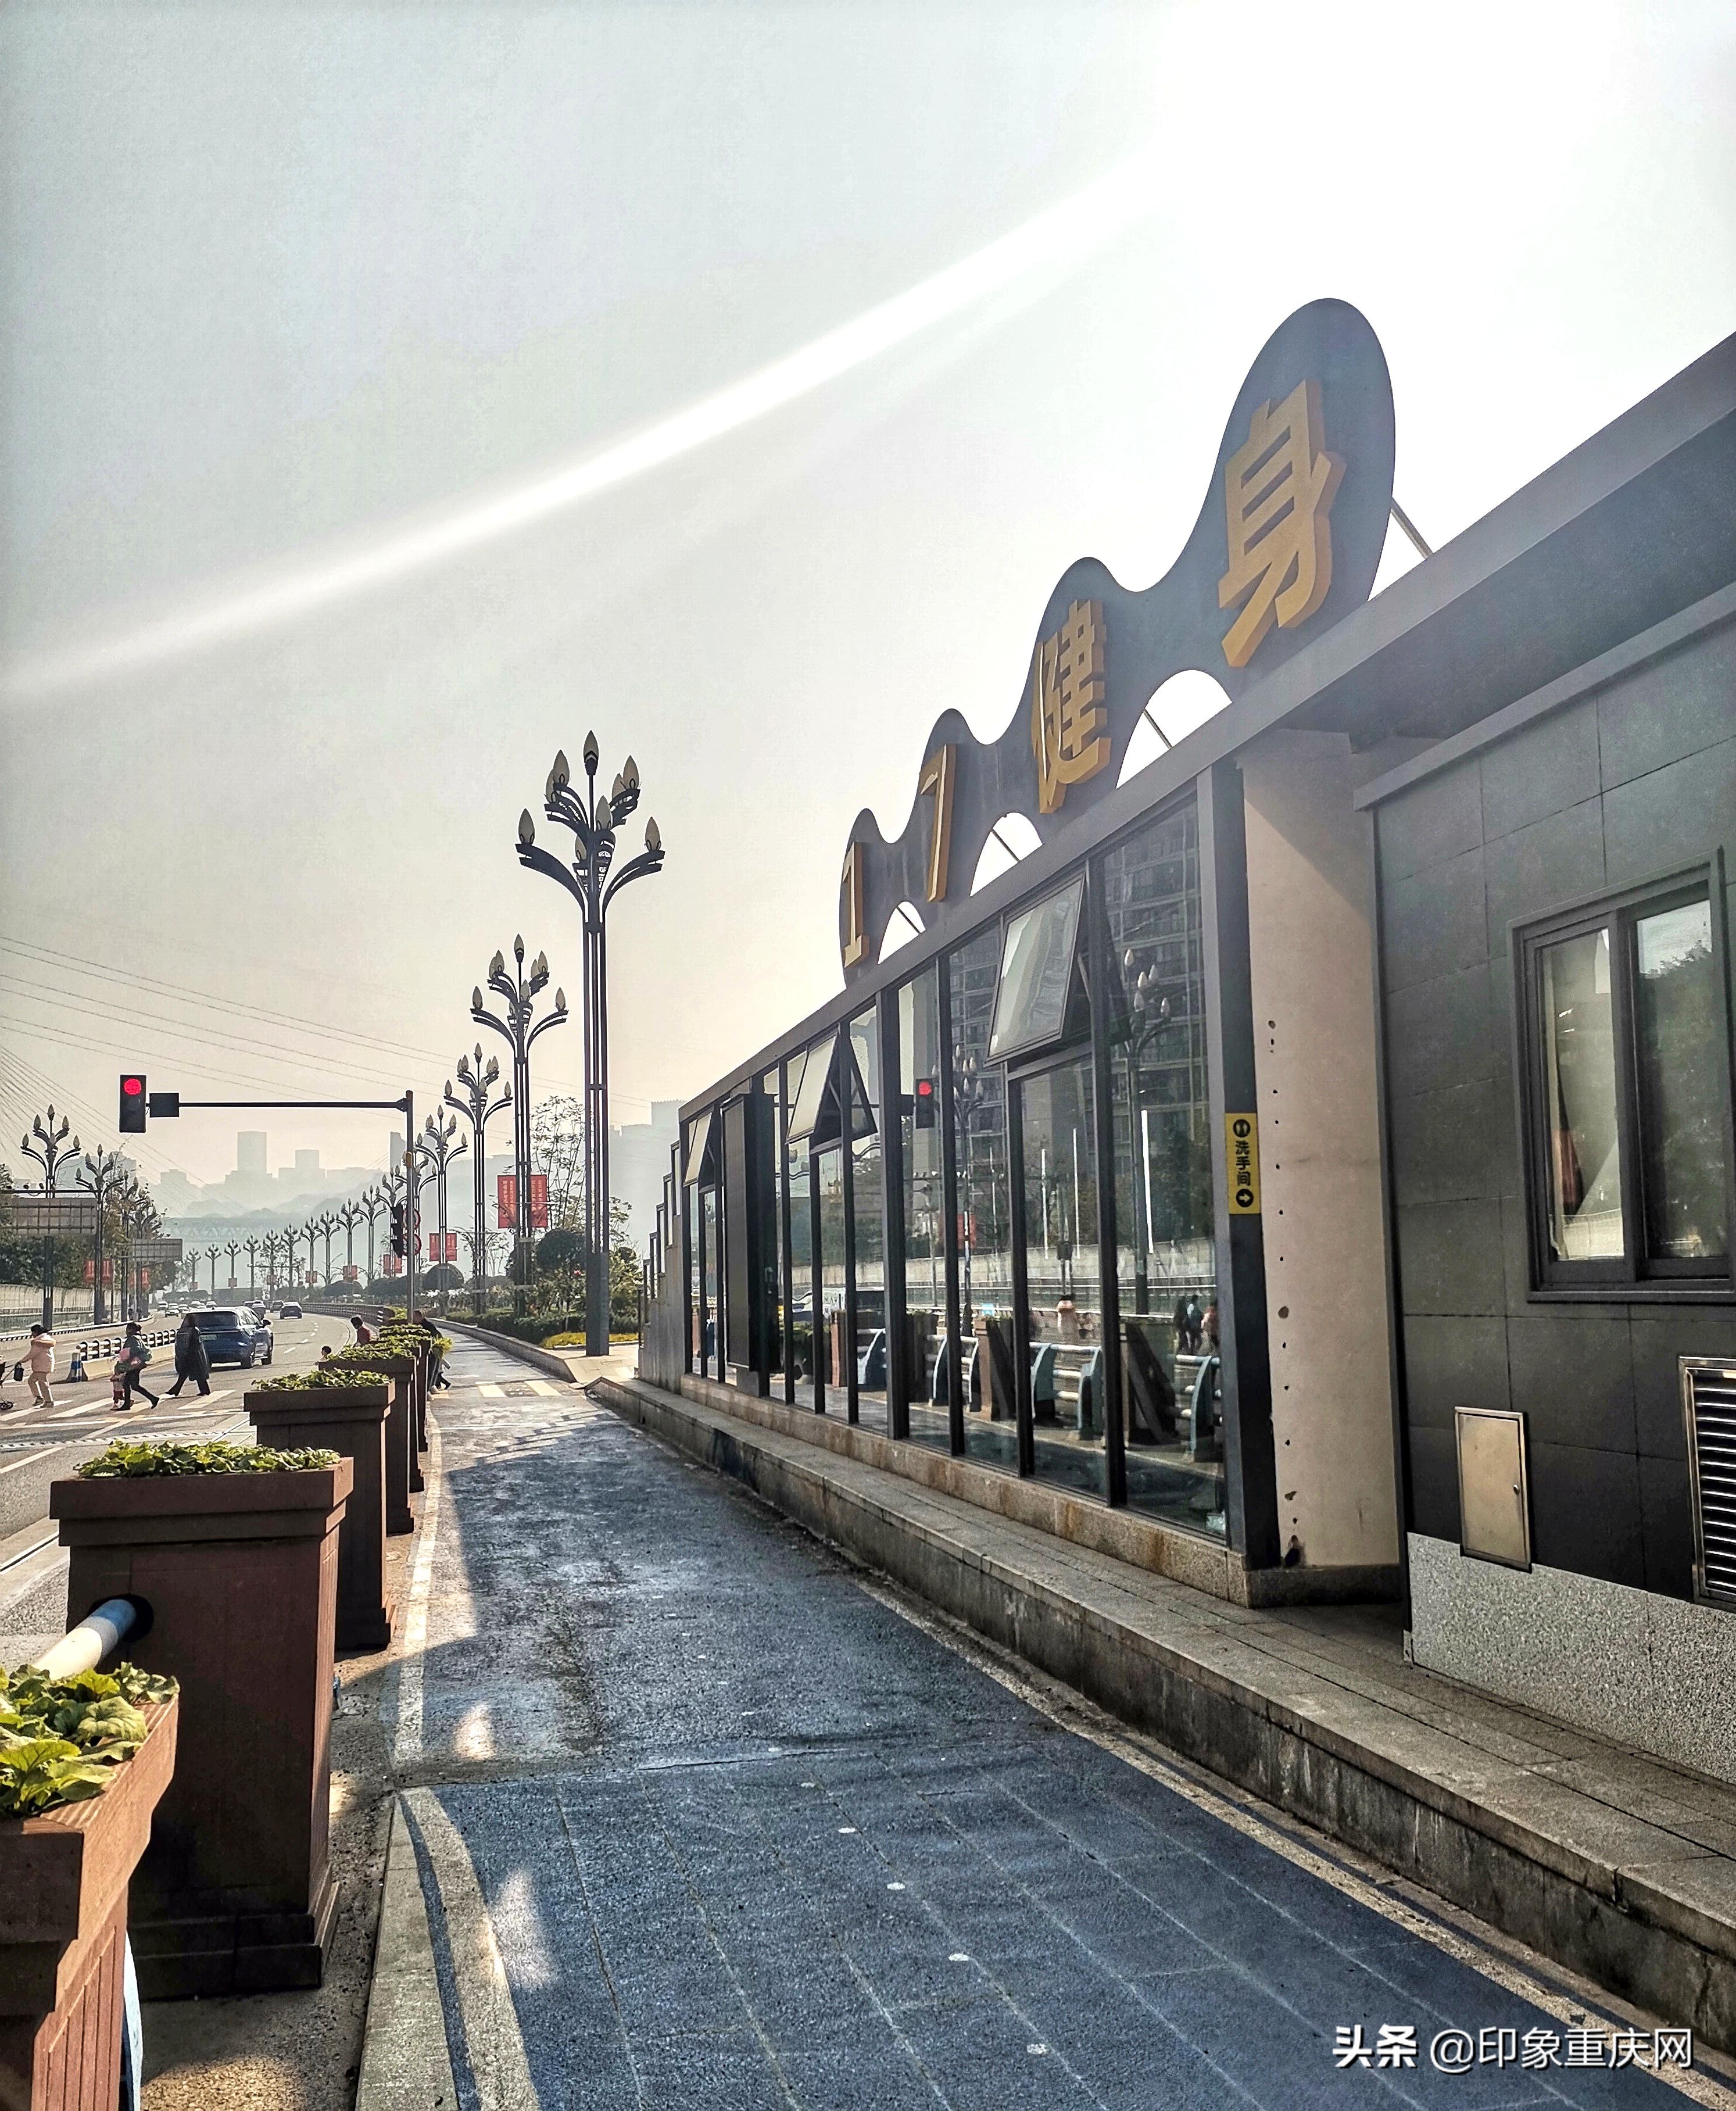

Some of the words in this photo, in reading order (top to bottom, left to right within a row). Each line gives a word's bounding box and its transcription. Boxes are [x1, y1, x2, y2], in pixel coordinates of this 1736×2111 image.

[842, 380, 1347, 967] 17健身
[1236, 1141, 1251, 1186] 洗手间
